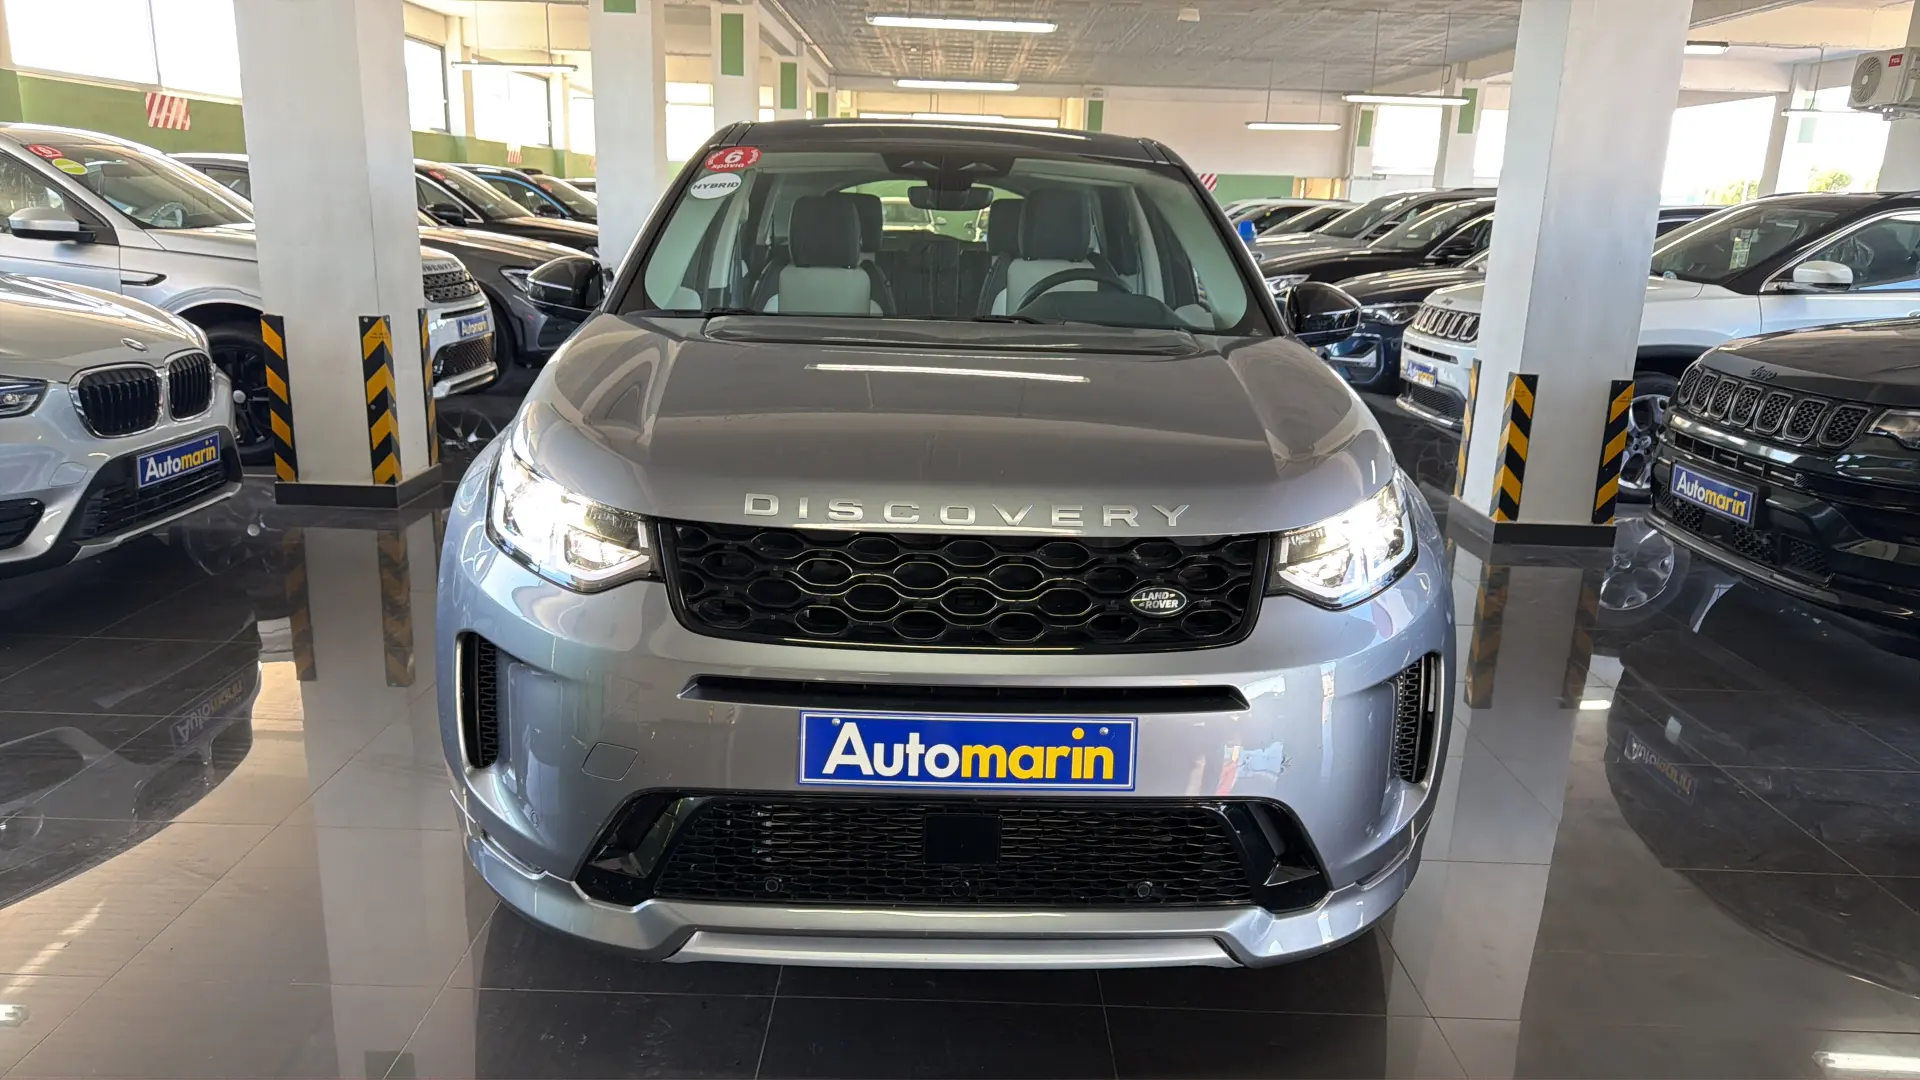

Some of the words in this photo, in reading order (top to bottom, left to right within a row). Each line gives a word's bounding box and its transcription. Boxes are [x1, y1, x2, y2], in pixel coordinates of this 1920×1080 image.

[725, 151, 744, 164] 6
[693, 181, 739, 190] HYBRID
[145, 440, 217, 482] Automarin
[1676, 471, 1746, 517] Automarin
[744, 493, 1191, 527] DISCOVERY
[1142, 592, 1170, 600] LAND
[1145, 600, 1179, 609] ROVER
[821, 722, 1115, 780] Automarin
